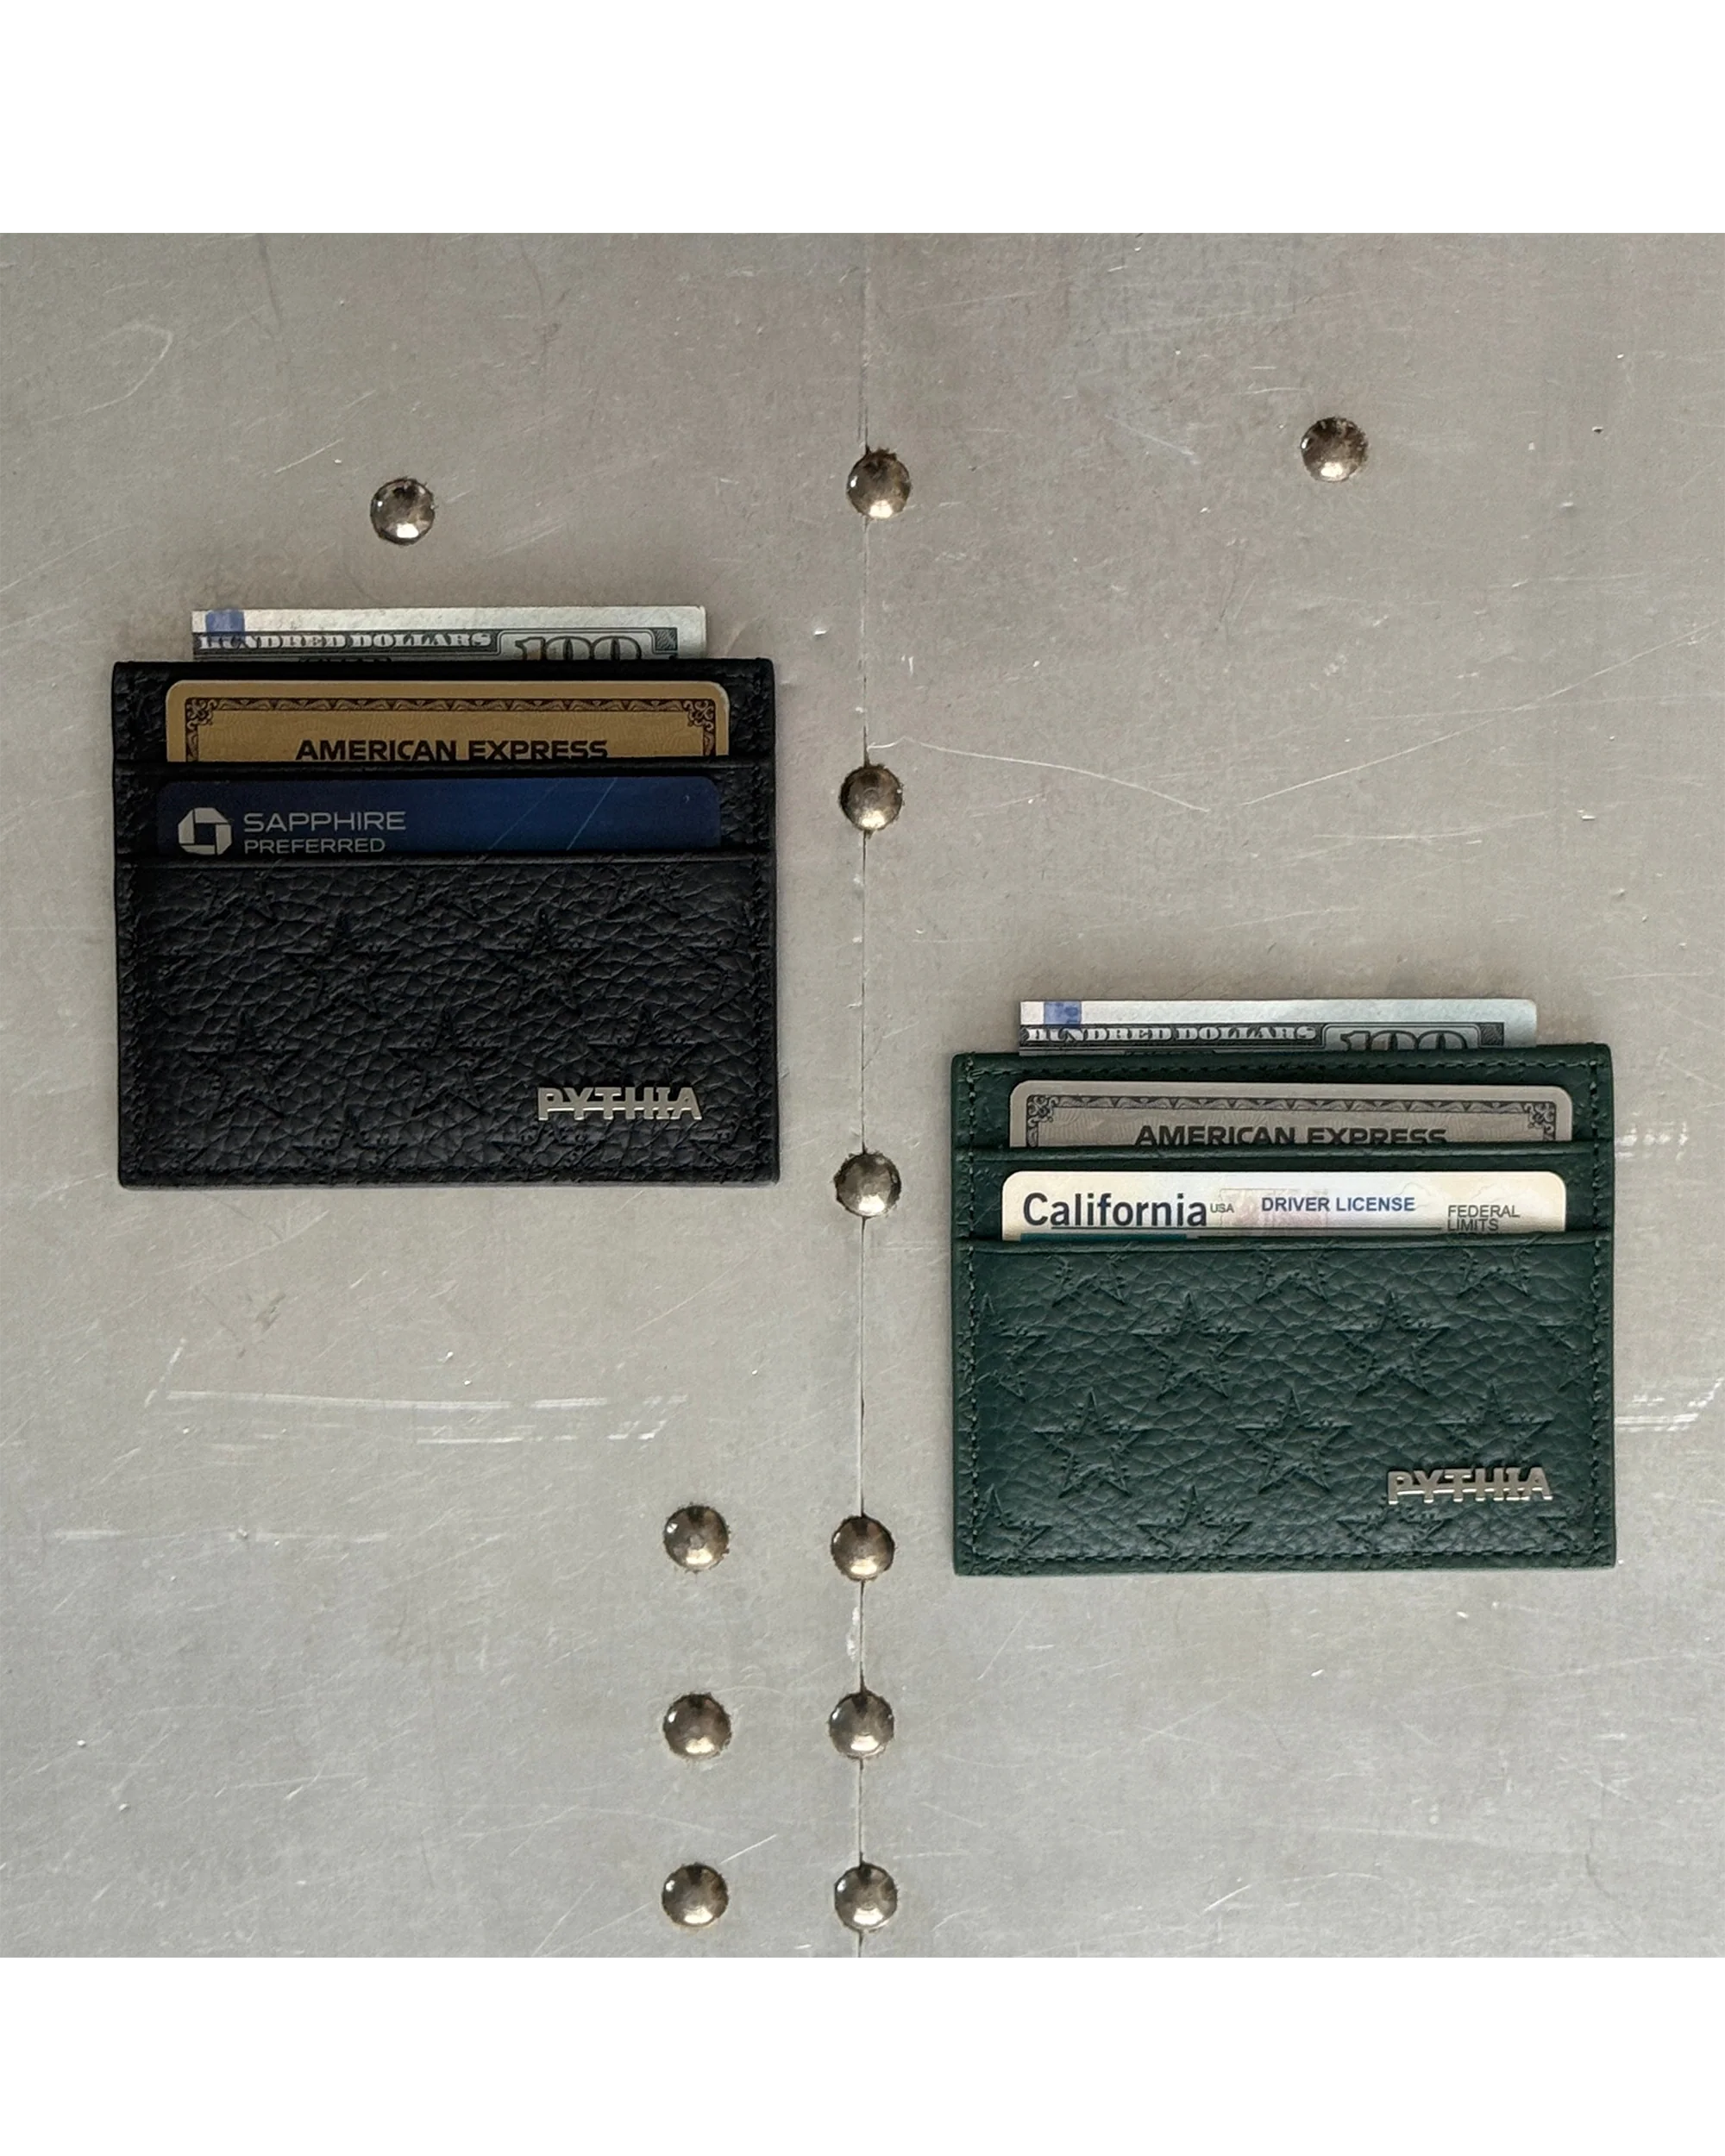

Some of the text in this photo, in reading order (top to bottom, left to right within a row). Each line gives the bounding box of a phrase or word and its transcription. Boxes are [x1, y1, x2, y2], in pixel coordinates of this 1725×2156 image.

[349, 632, 492, 648] DOLLARS
[295, 739, 608, 761] AMERICAN EXPRESS
[244, 812, 406, 832] SAPPHIRE
[244, 838, 386, 854] PREFERRED
[1026, 1026, 1316, 1042] HUNDRED DOLLARS
[537, 1087, 703, 1120] PYTHIA
[1134, 1125, 1447, 1145] AMERICAN EXPRESS
[1023, 1192, 1234, 1227] California USA
[1261, 1197, 1415, 1212] DRIVER LICENSE
[1447, 1205, 1520, 1218] FEDERAL
[1447, 1219, 1499, 1232] LIMITS
[1388, 1467, 1552, 1505] PYTHIA
